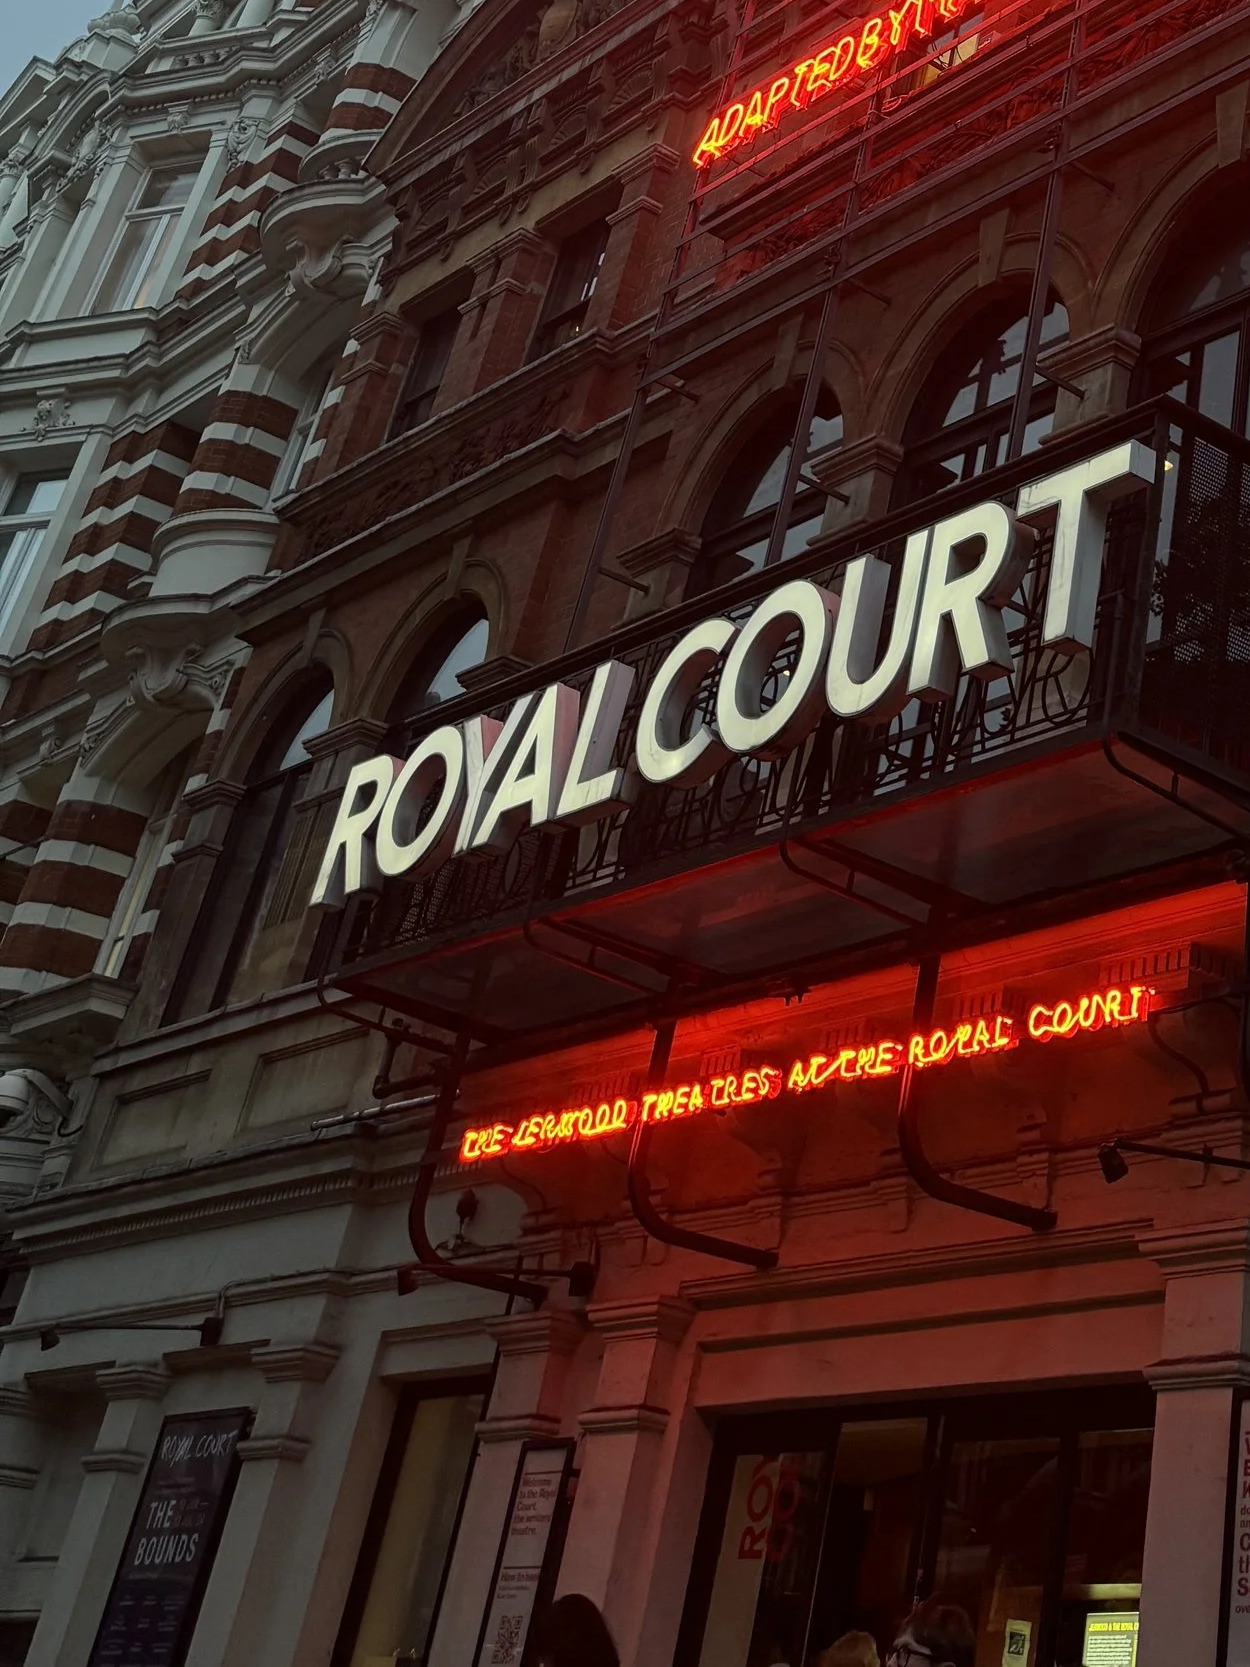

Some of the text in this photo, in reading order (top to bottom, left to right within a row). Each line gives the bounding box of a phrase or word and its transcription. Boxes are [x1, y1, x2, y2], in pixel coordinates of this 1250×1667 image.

[692, 35, 858, 170] ADAPTED
[307, 439, 1157, 916] ROYAL COURT
[459, 1124, 512, 1162] THE
[641, 1065, 783, 1123] THEATRES
[838, 1040, 904, 1079] THE
[907, 1016, 1016, 1069] ROYAL
[1027, 985, 1156, 1043] COURT
[160, 1429, 239, 1468] ROYAL COURT
[133, 1533, 200, 1566] BOUNDS
[145, 1499, 178, 1530] THE
